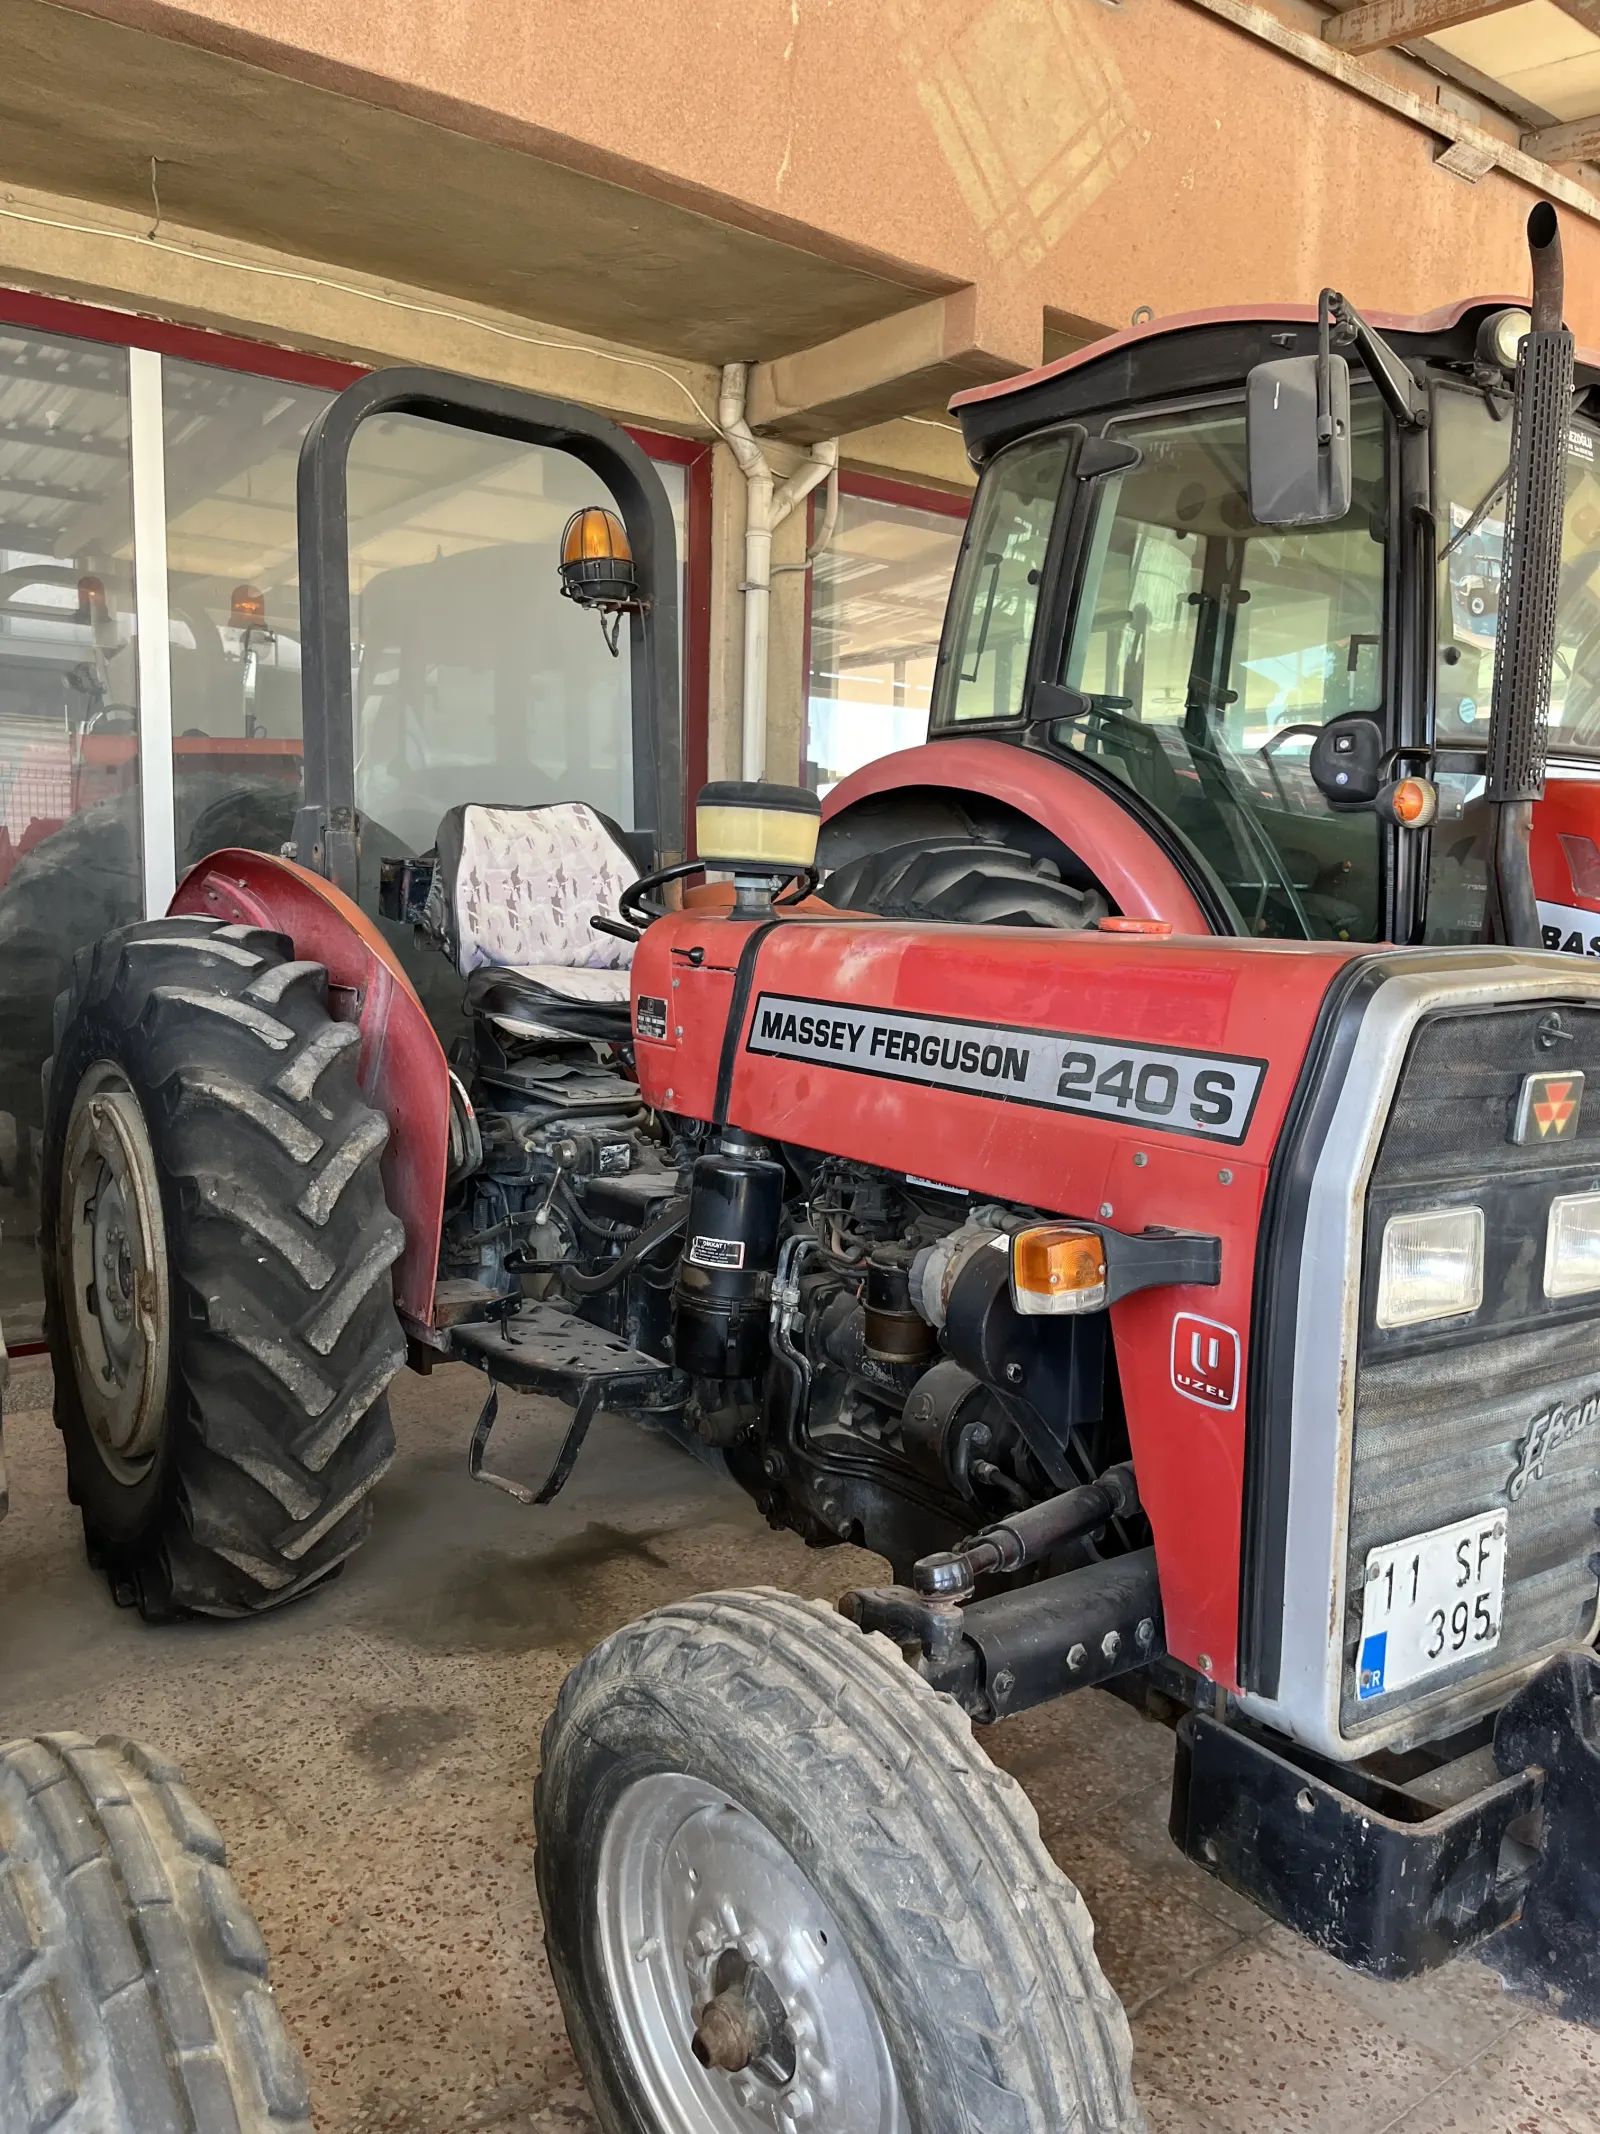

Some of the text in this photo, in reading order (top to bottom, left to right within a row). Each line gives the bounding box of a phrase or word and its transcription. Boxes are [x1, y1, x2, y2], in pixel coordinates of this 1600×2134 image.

[760, 1010, 1235, 1125] MASSEY FERGUSON 240 S
[1177, 1373, 1229, 1401] UZEL
[1510, 1398, 1600, 1500] Efsan
[1384, 1530, 1494, 1611] 11 SF
[1427, 1592, 1492, 1659] 395
